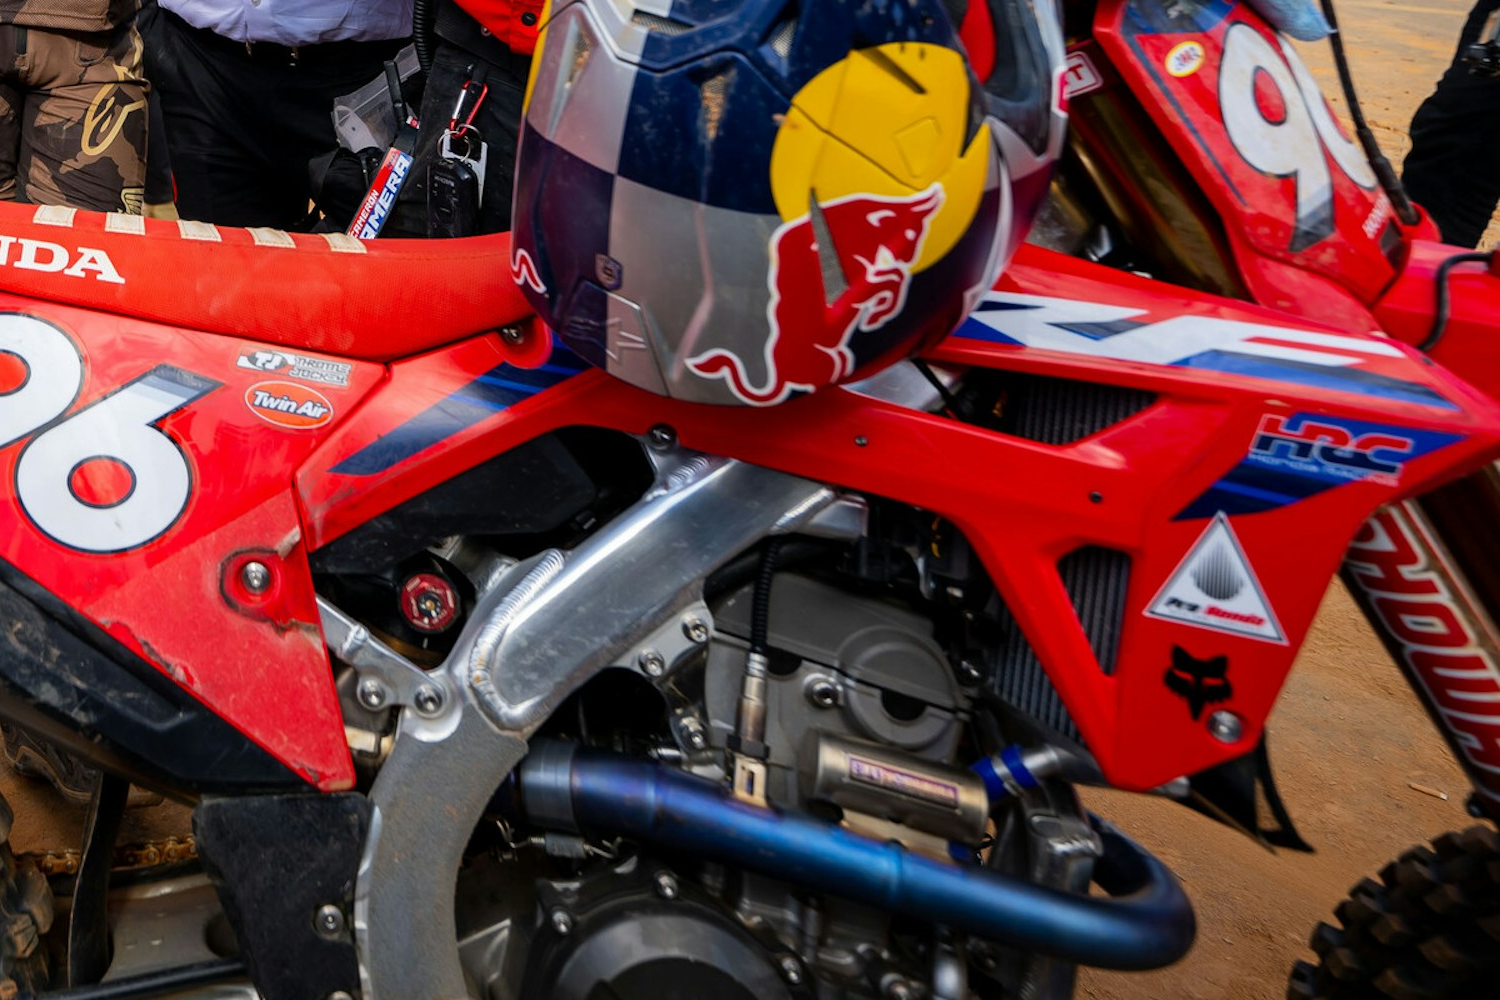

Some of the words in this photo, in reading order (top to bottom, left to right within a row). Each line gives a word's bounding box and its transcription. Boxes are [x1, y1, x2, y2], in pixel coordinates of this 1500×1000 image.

[290, 367, 350, 388] JOCKEY
[252, 390, 297, 414] Twin
[296, 400, 328, 419] Air
[1250, 413, 1413, 476] HRC
